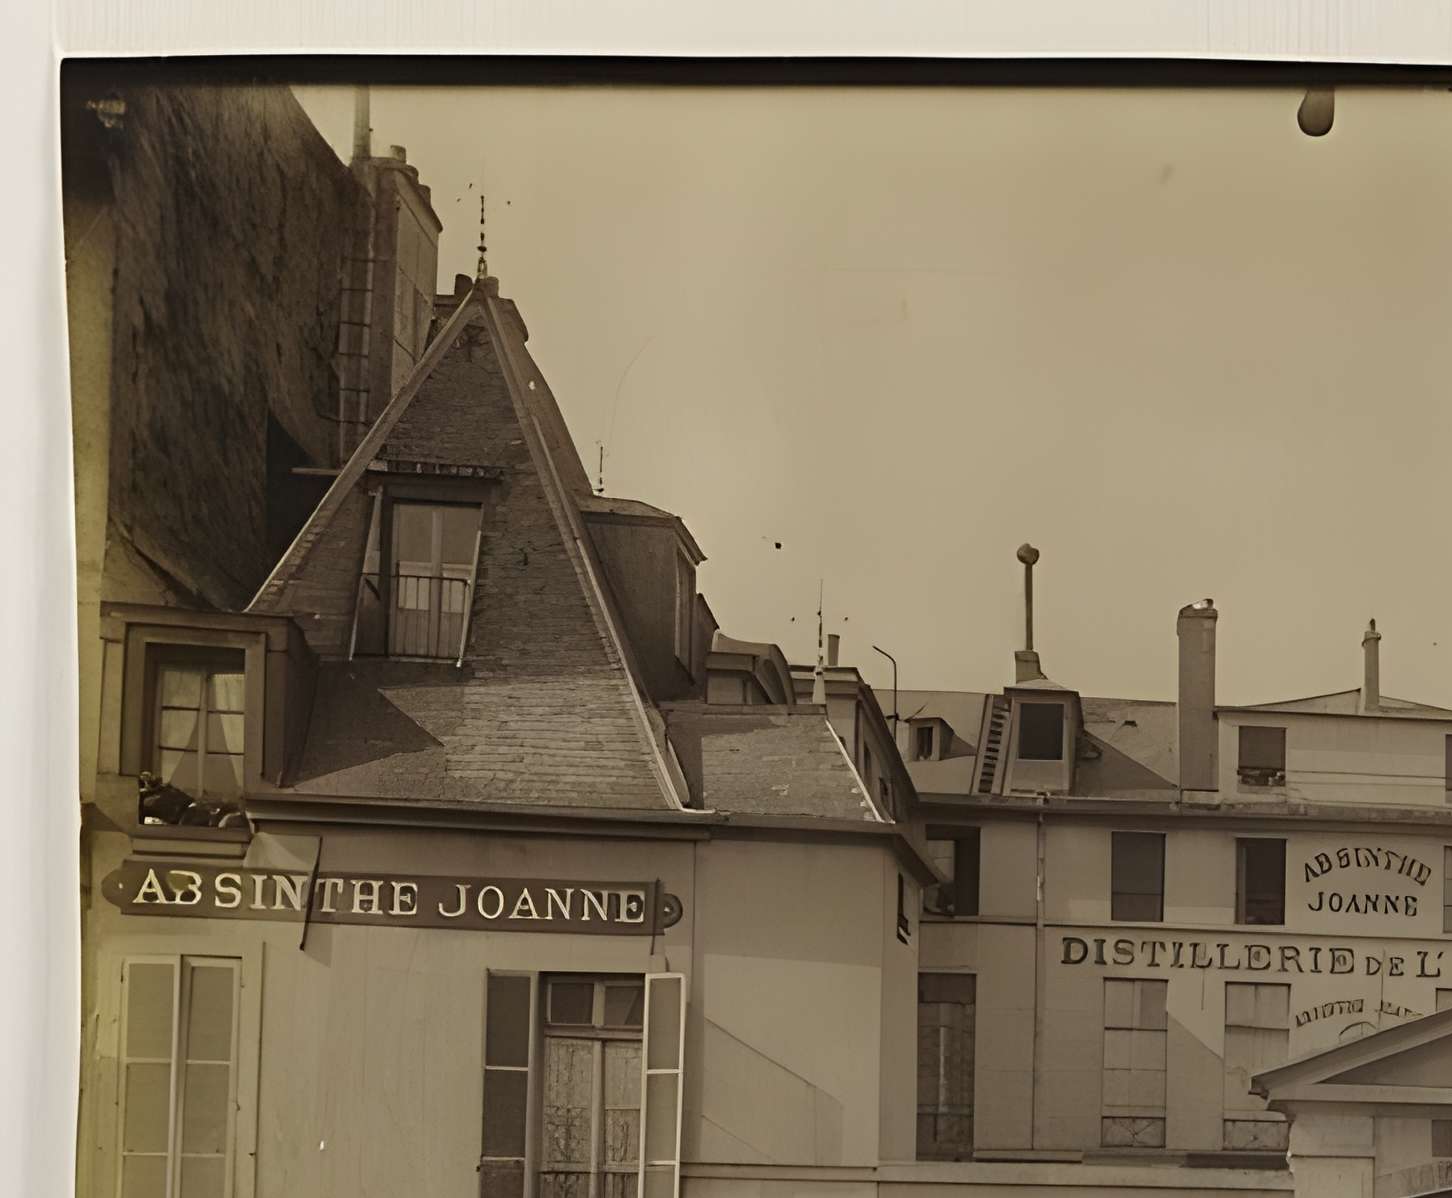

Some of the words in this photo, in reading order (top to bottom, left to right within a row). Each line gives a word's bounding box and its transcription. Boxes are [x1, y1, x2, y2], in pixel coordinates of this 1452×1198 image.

[132, 868, 418, 915] ABSINTHE
[438, 884, 645, 923] JOANNE
[1307, 891, 1418, 917] JOANNE
[1060, 937, 1355, 975] DISTILLERIE
